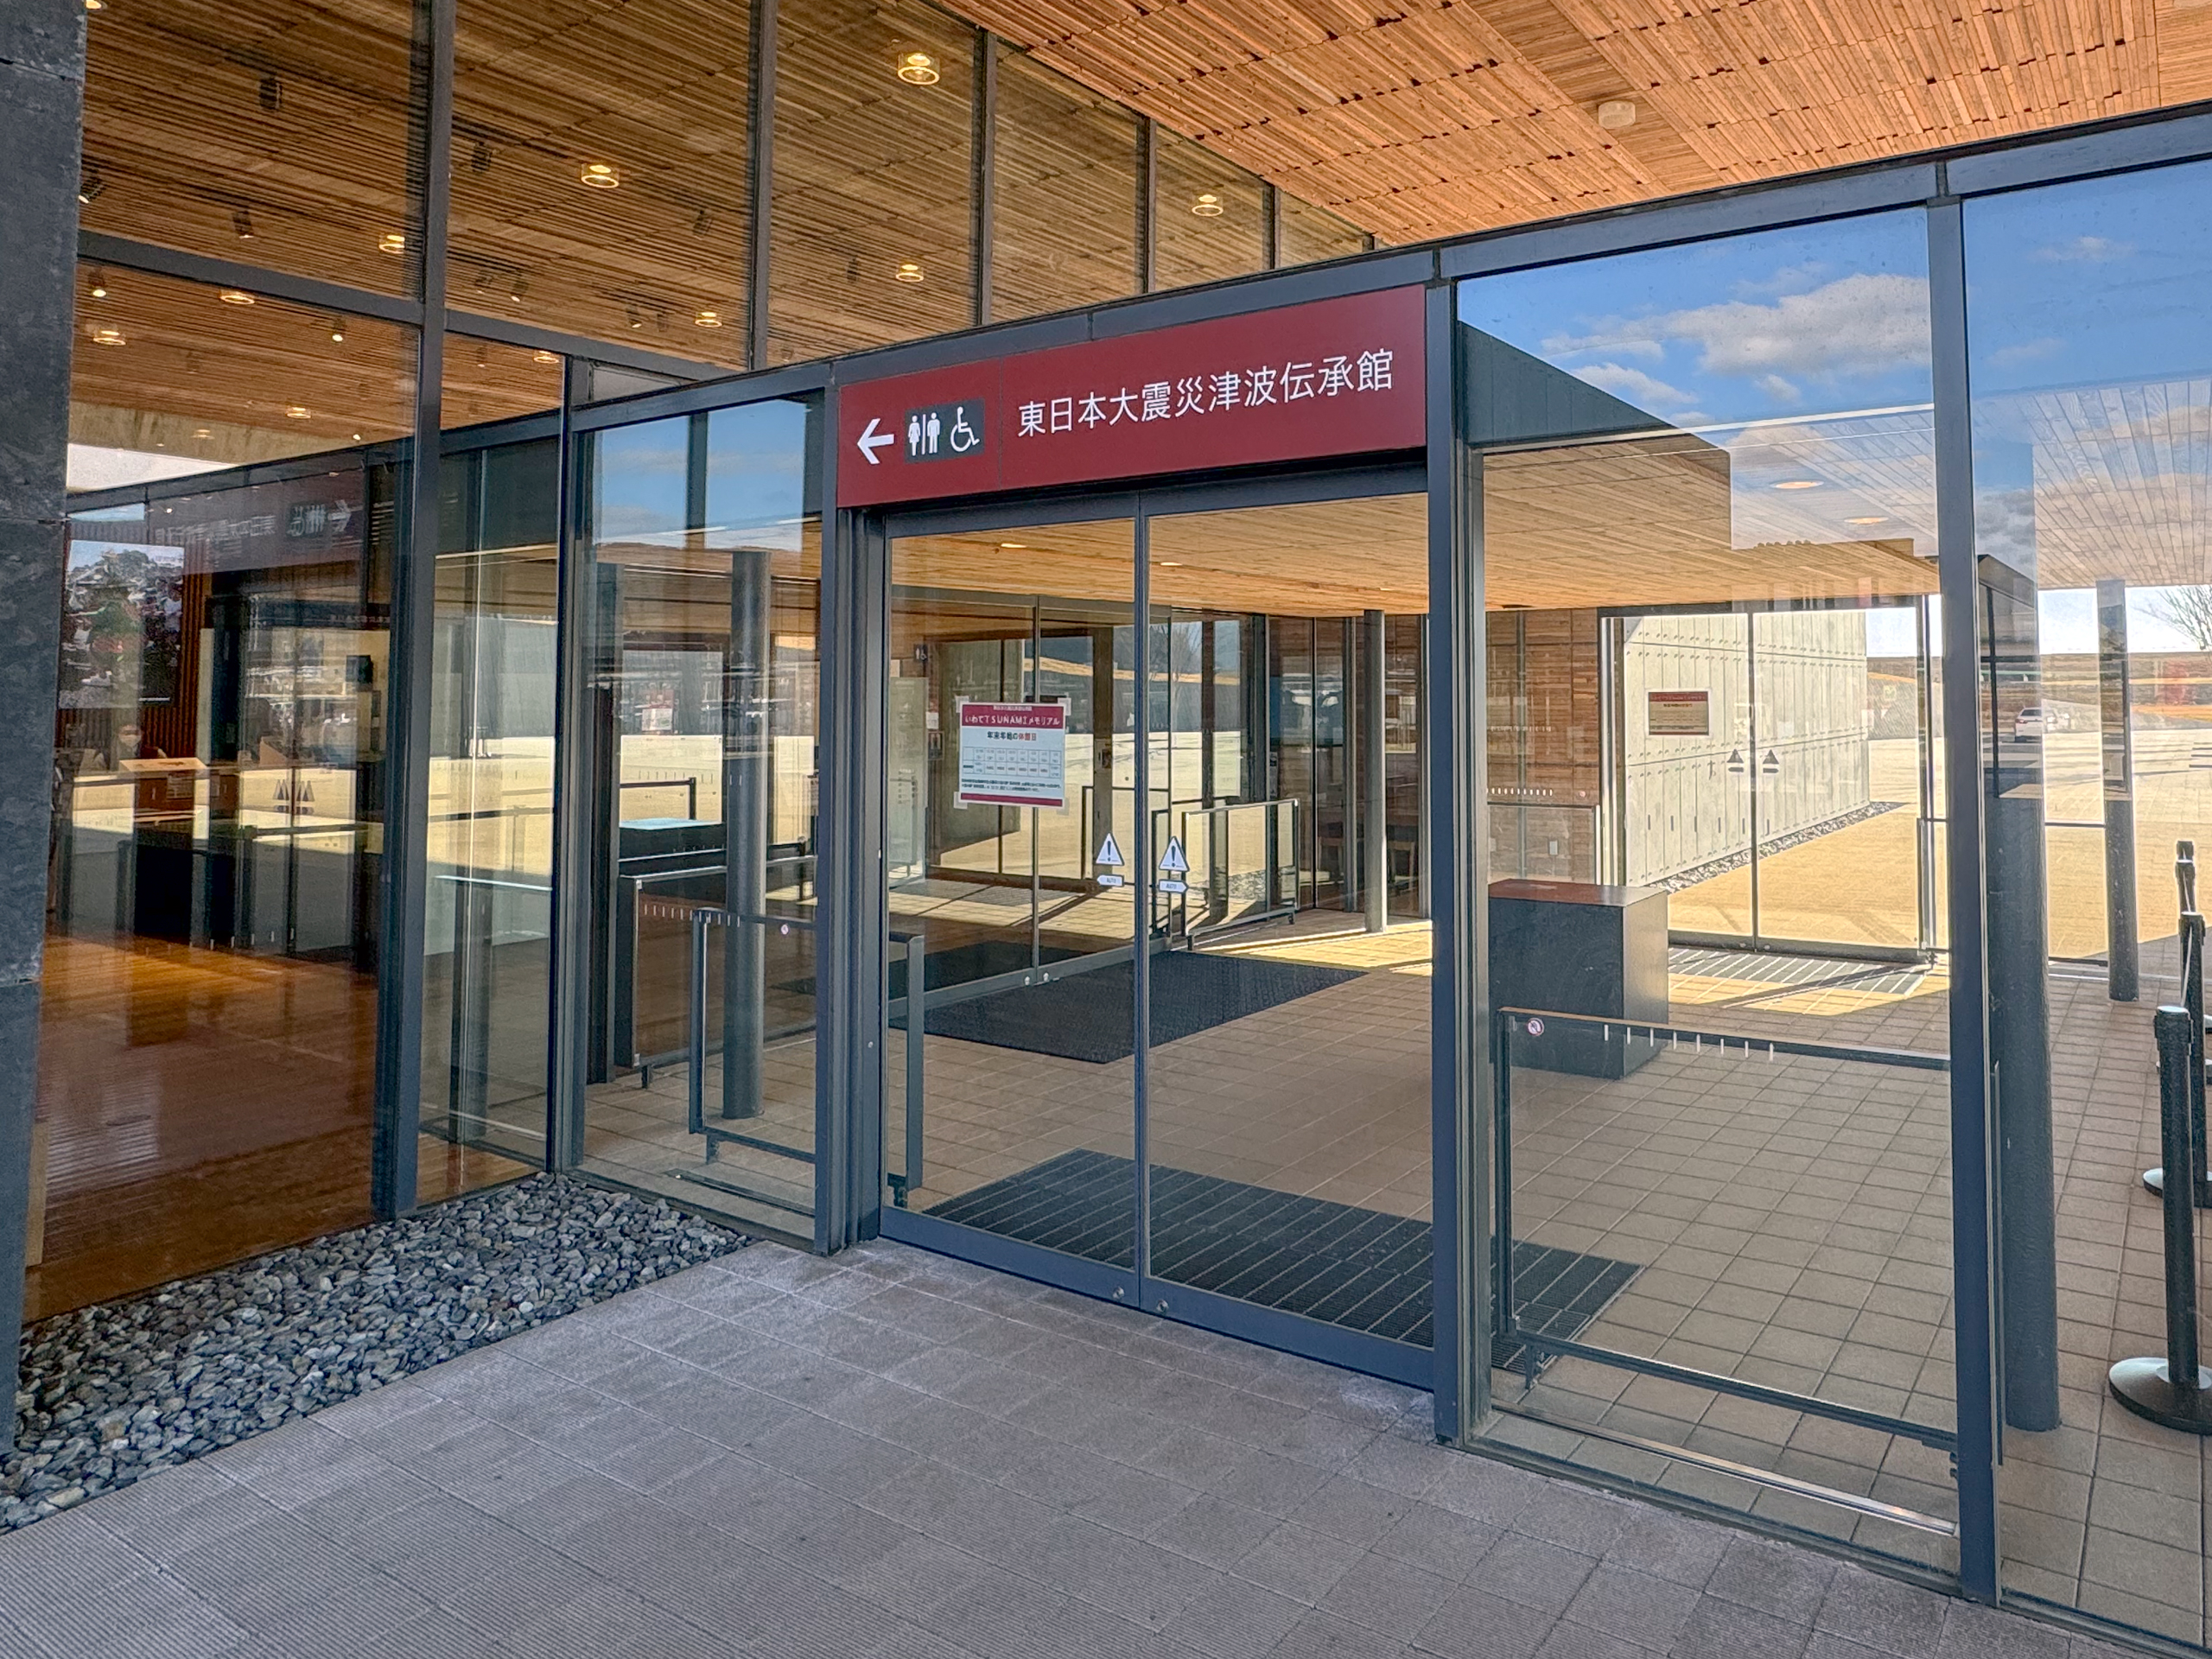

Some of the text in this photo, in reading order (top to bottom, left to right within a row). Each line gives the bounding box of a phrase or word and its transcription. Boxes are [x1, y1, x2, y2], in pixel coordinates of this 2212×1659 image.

[1018, 348, 1394, 437] 東日本大震災津波伝承館
